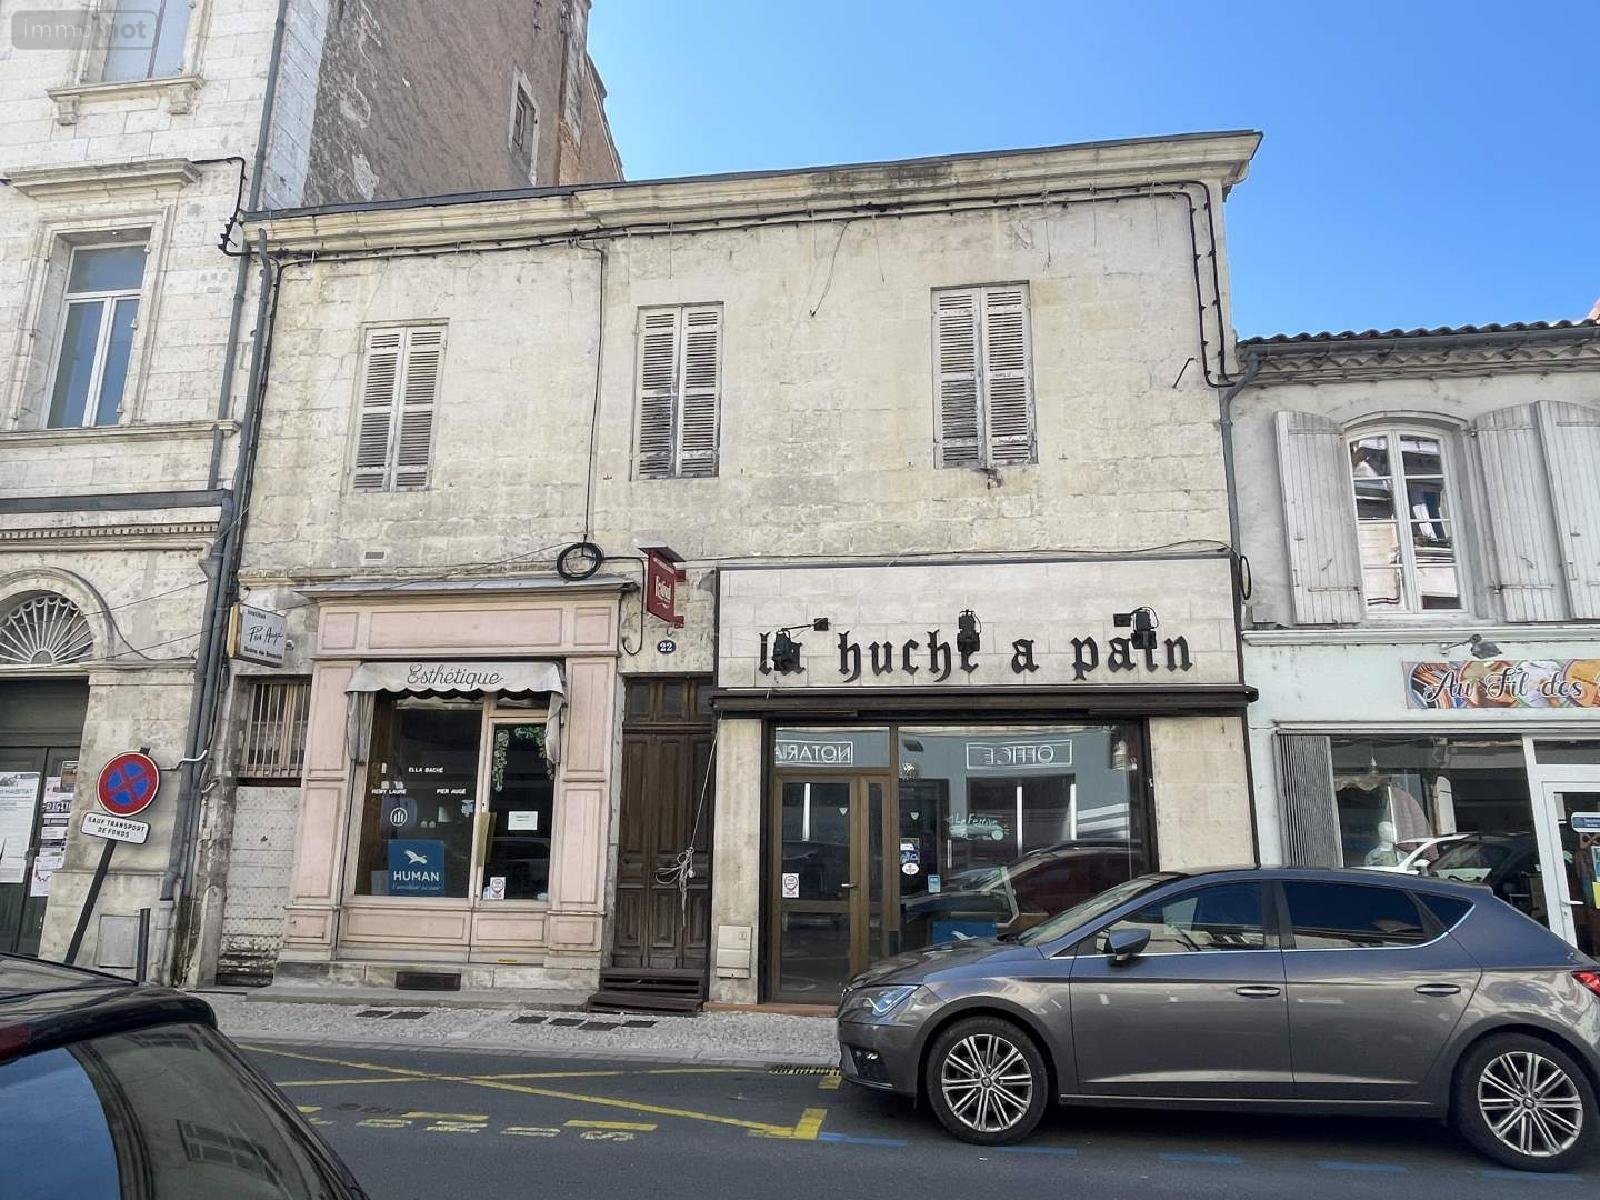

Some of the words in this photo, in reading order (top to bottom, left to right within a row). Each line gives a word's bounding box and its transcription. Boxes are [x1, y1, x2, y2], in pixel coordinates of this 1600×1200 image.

[660, 641, 673, 652] 22
[838, 630, 979, 683] huche
[1011, 638, 1040, 674] a
[1070, 636, 1193, 681] pain
[407, 663, 504, 690] Esthétique
[1424, 671, 1473, 701] Au
[1485, 666, 1530, 698] Fil
[1539, 671, 1583, 698] des
[107, 820, 145, 832] TRANSPORT
[393, 870, 440, 882] HUMAN
